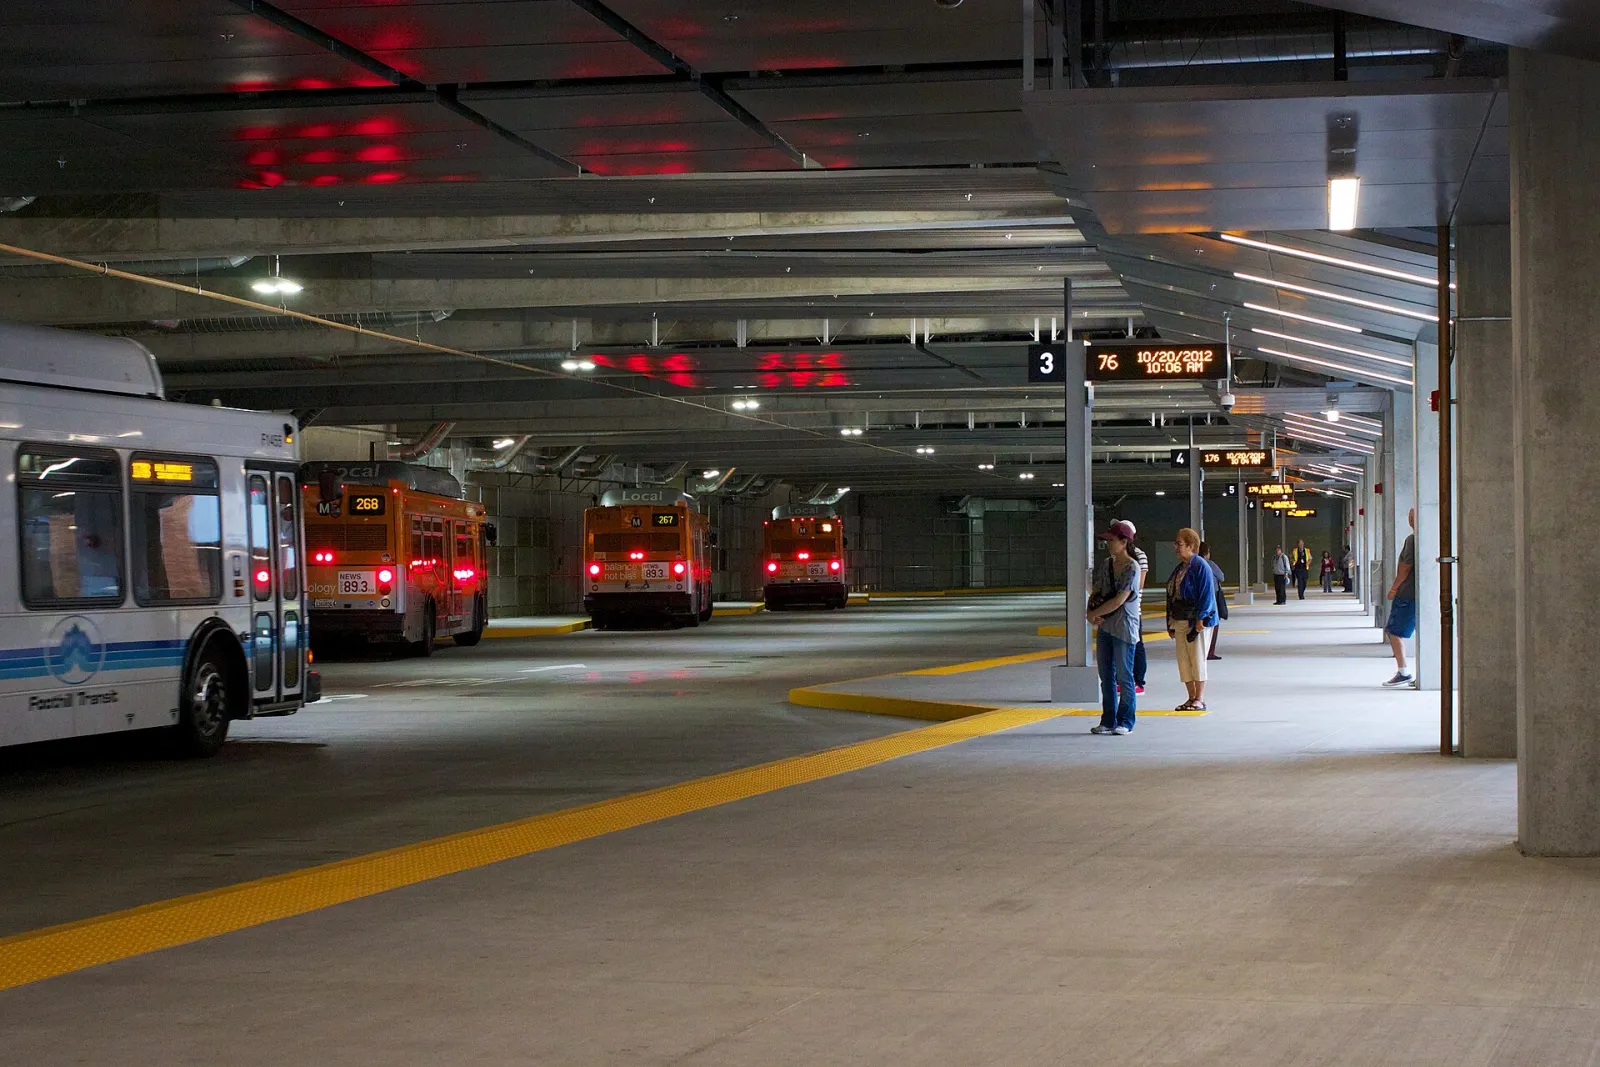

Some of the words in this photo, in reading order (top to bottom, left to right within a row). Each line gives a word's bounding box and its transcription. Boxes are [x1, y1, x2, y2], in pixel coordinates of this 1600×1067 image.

[1098, 354, 1119, 370] 76
[1137, 351, 1213, 363] 10/20/2012
[1040, 352, 1054, 374] 3
[1146, 362, 1182, 374] 10:06
[1186, 362, 1204, 373] AM
[1176, 452, 1184, 464] 4
[1204, 454, 1220, 463] 176
[1226, 452, 1265, 460] 10/20/2012
[336, 463, 380, 478] ocal
[1229, 485, 1235, 494] 5
[622, 491, 663, 501] Local
[319, 503, 330, 514] M
[356, 498, 379, 510] 268
[788, 507, 819, 515] Local
[632, 519, 640, 527] M
[658, 515, 674, 524] 267
[645, 569, 664, 578] 89.3
[308, 583, 336, 595] ology
[343, 580, 368, 593] 89.3
